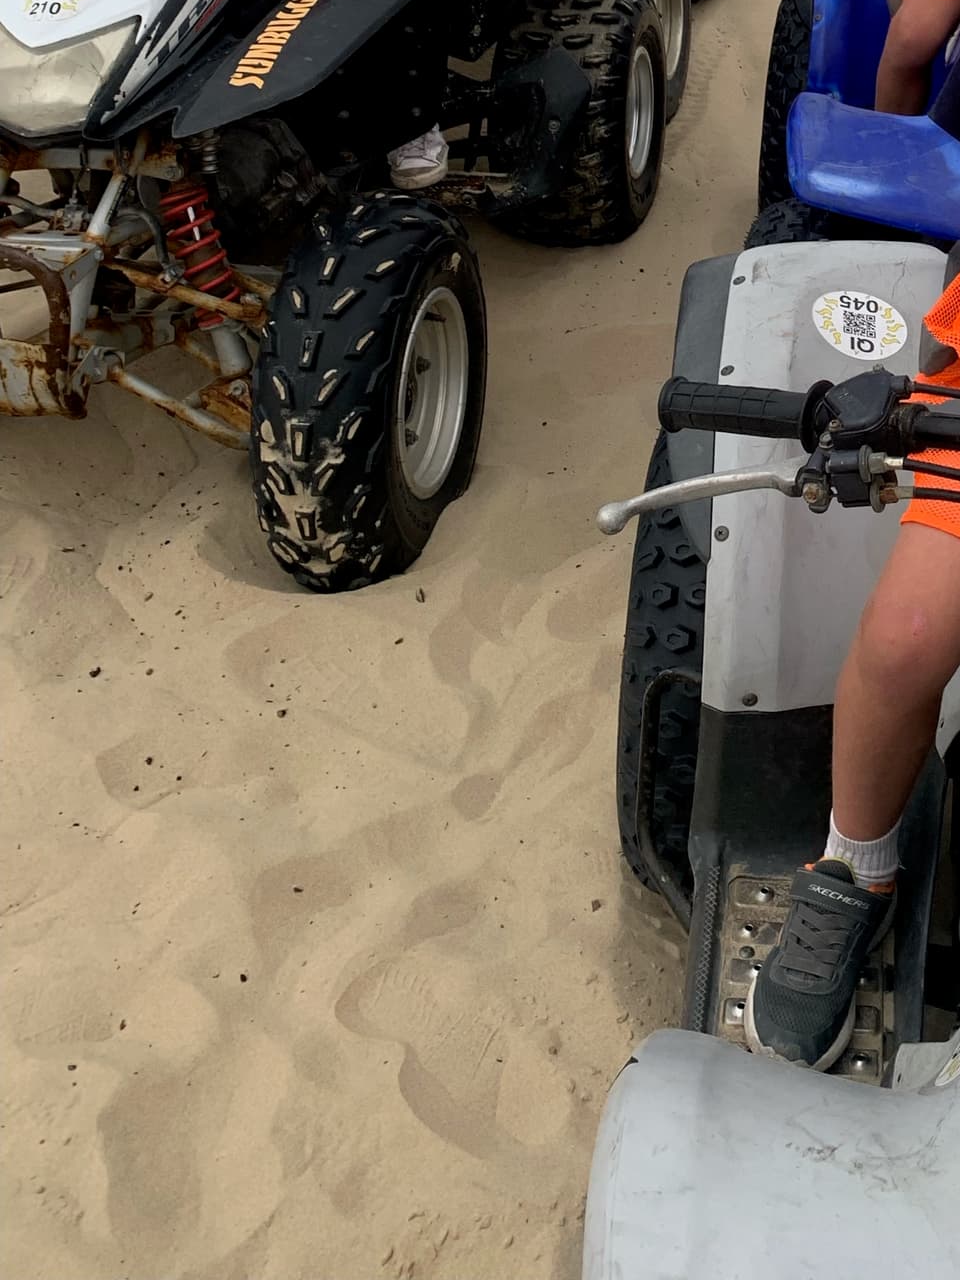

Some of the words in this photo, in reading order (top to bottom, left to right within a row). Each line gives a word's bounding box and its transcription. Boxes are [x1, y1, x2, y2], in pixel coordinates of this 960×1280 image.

[29, 1, 62, 15] 210
[839, 295, 879, 313] 045
[850, 336, 875, 353] QI
[807, 883, 869, 910] SKECHERS
